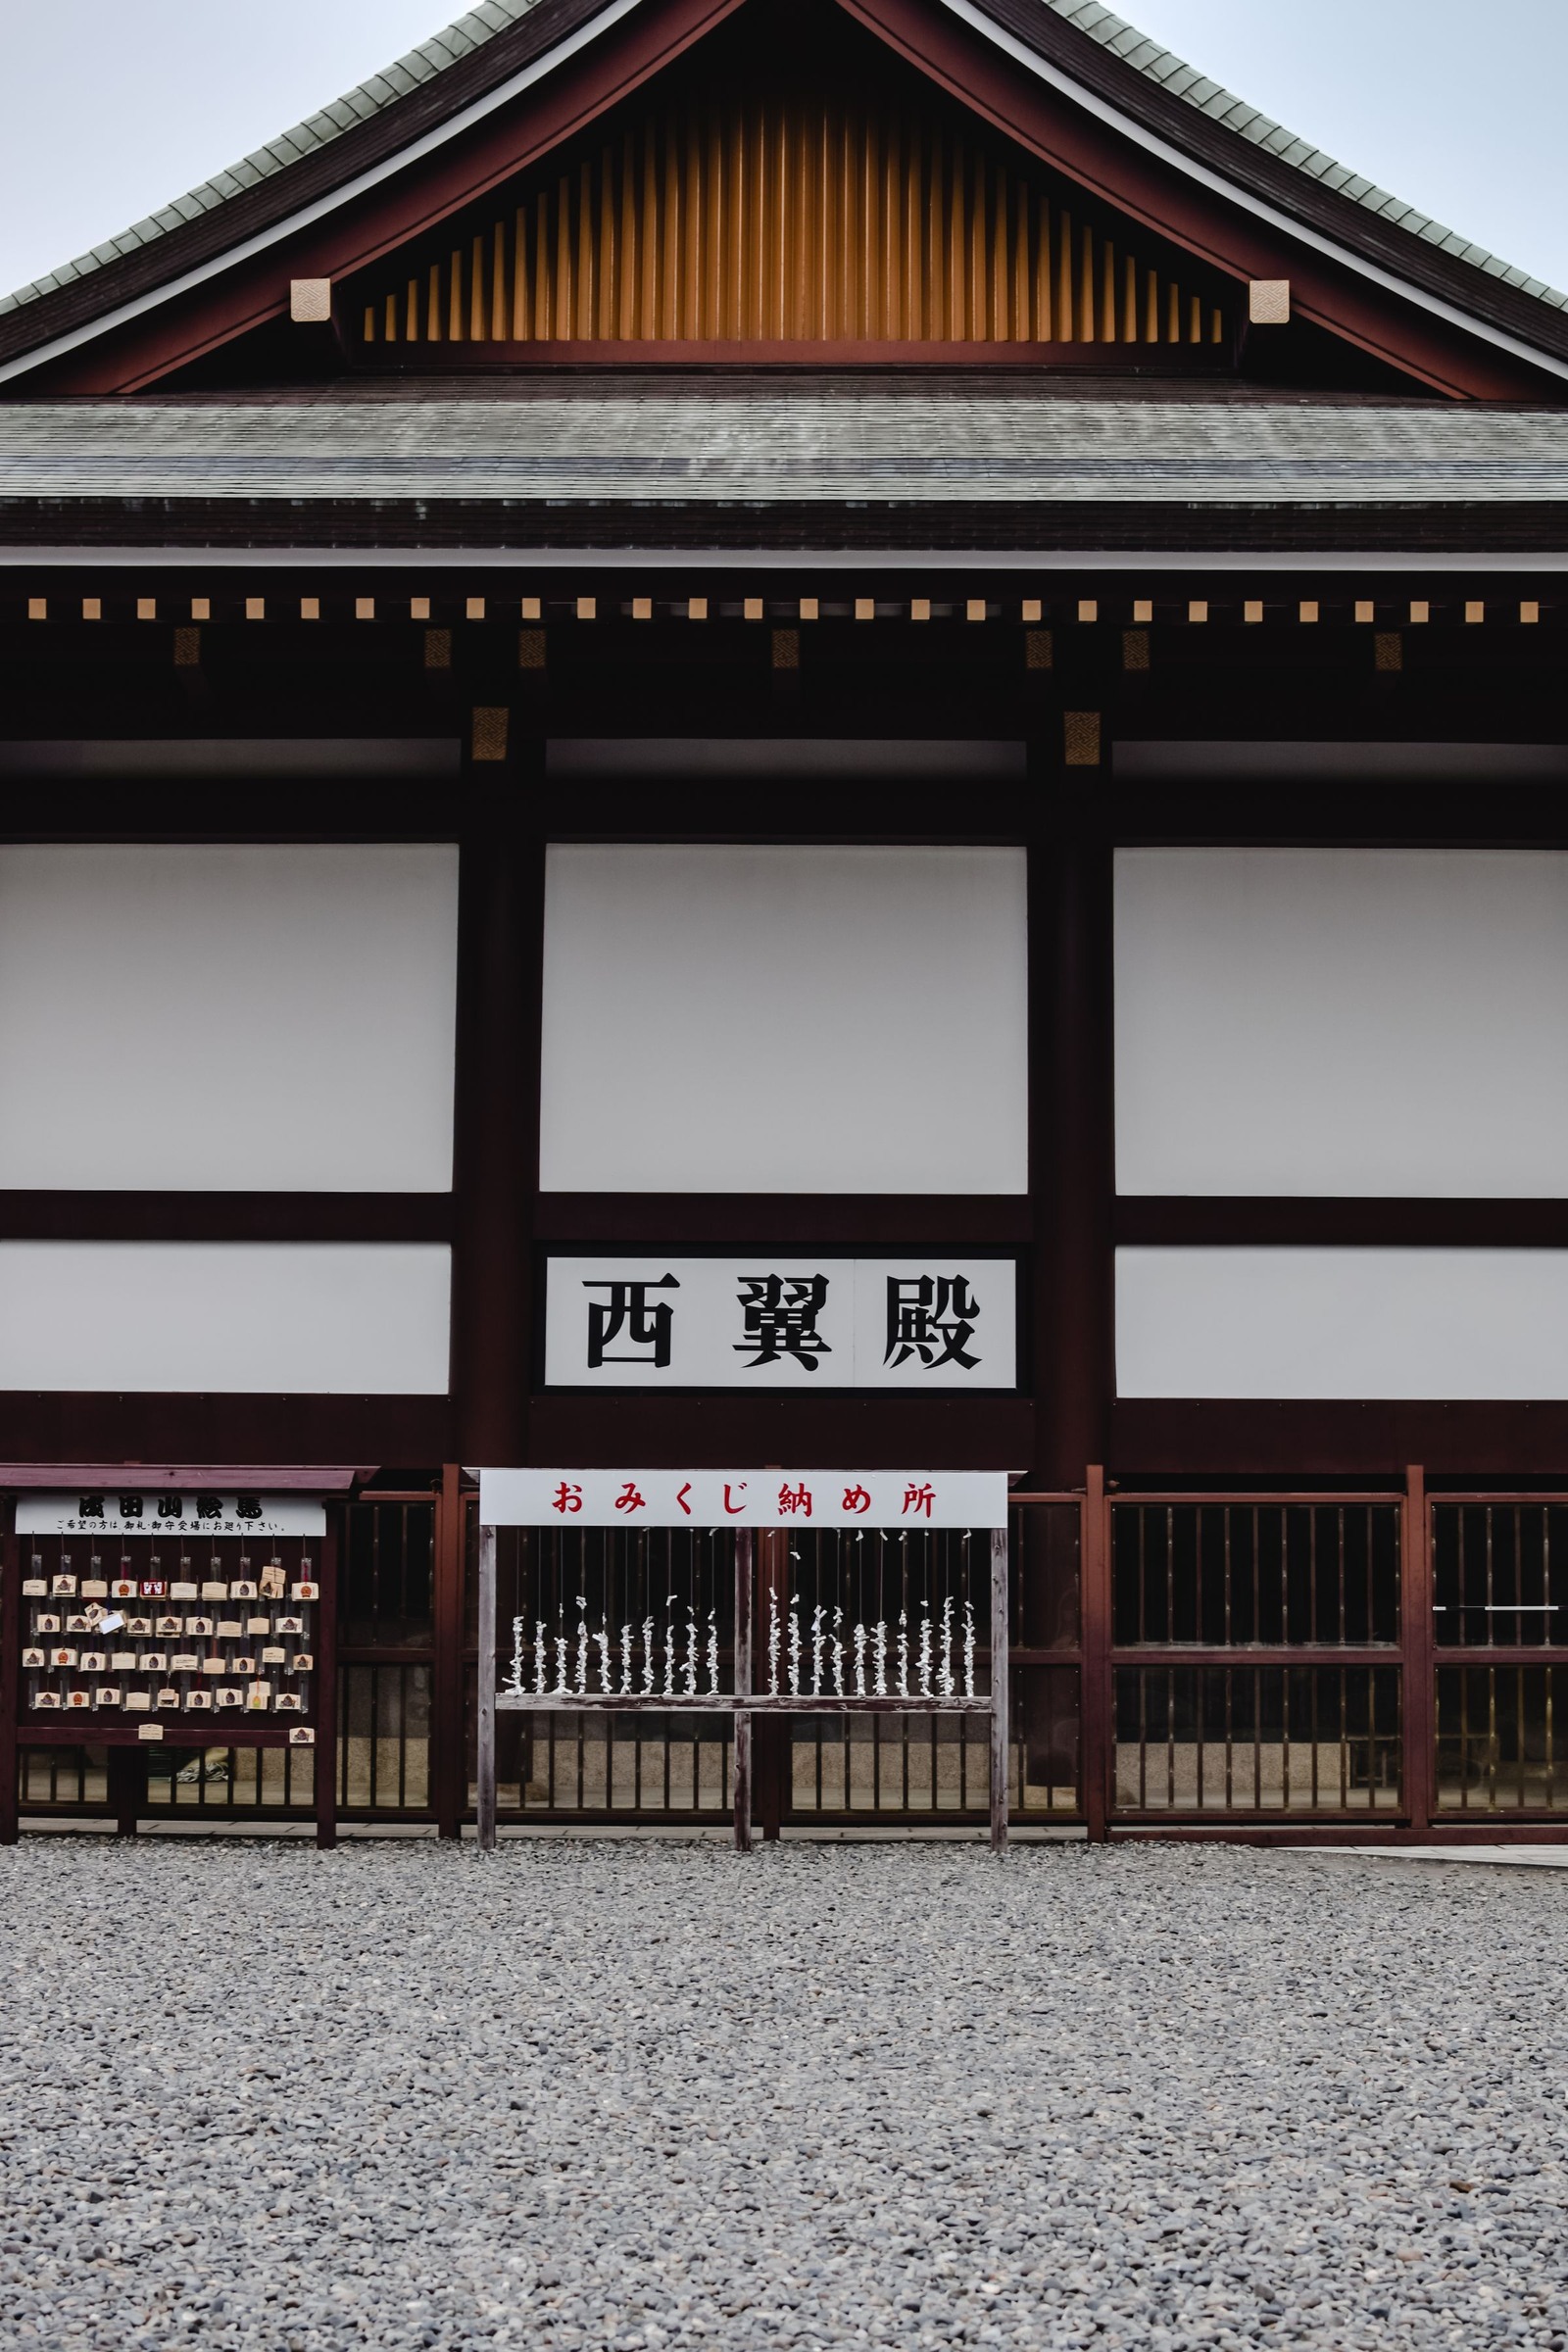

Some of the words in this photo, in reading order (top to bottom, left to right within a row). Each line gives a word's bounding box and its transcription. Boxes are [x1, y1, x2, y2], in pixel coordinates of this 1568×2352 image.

[582, 1272, 983, 1372] 西翼殿
[78, 1496, 263, 1519] 成田山絵馬
[553, 1481, 937, 1518] おみくじ納め所
